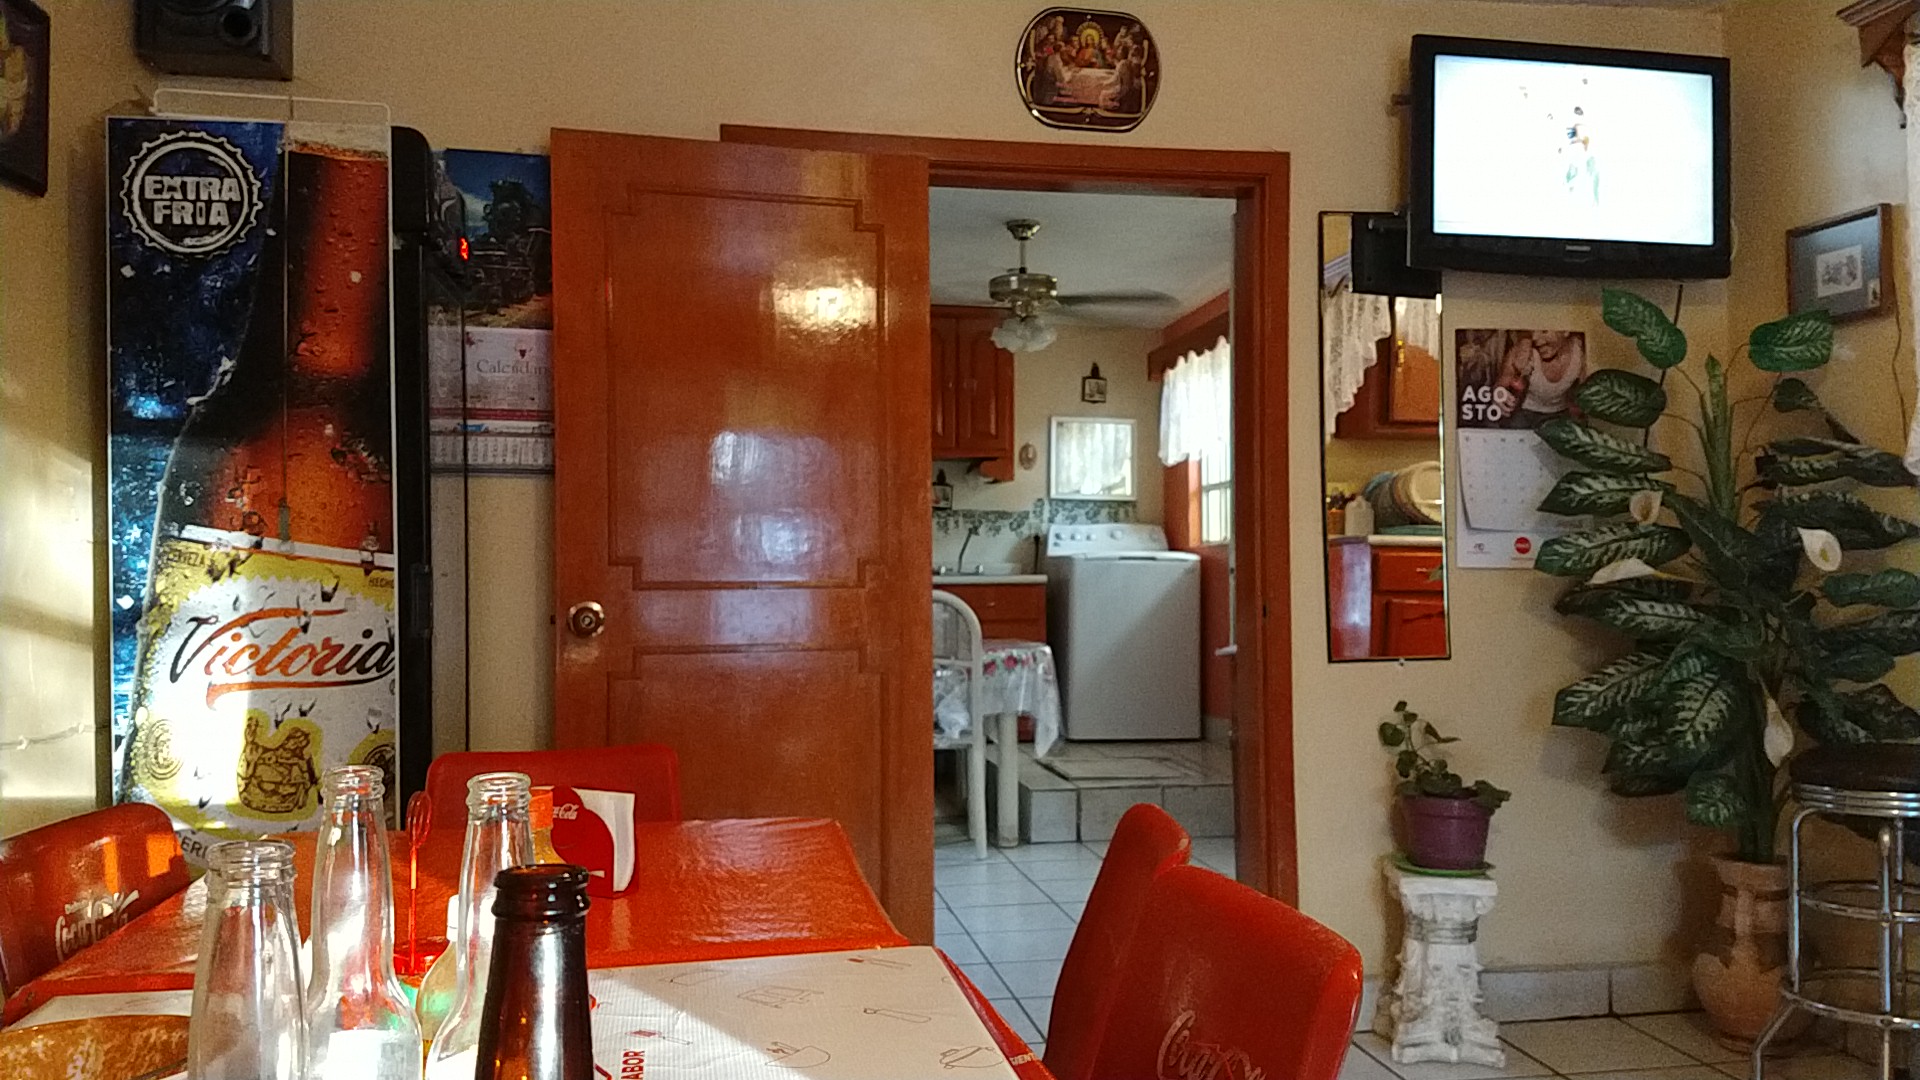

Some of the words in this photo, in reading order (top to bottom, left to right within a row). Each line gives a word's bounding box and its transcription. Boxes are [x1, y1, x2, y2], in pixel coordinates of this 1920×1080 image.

[144, 175, 241, 201] EXTRA
[153, 200, 230, 226] FRIA
[1462, 384, 1508, 403] AGO
[1462, 403, 1502, 422] STO
[169, 607, 395, 700] Victoria
